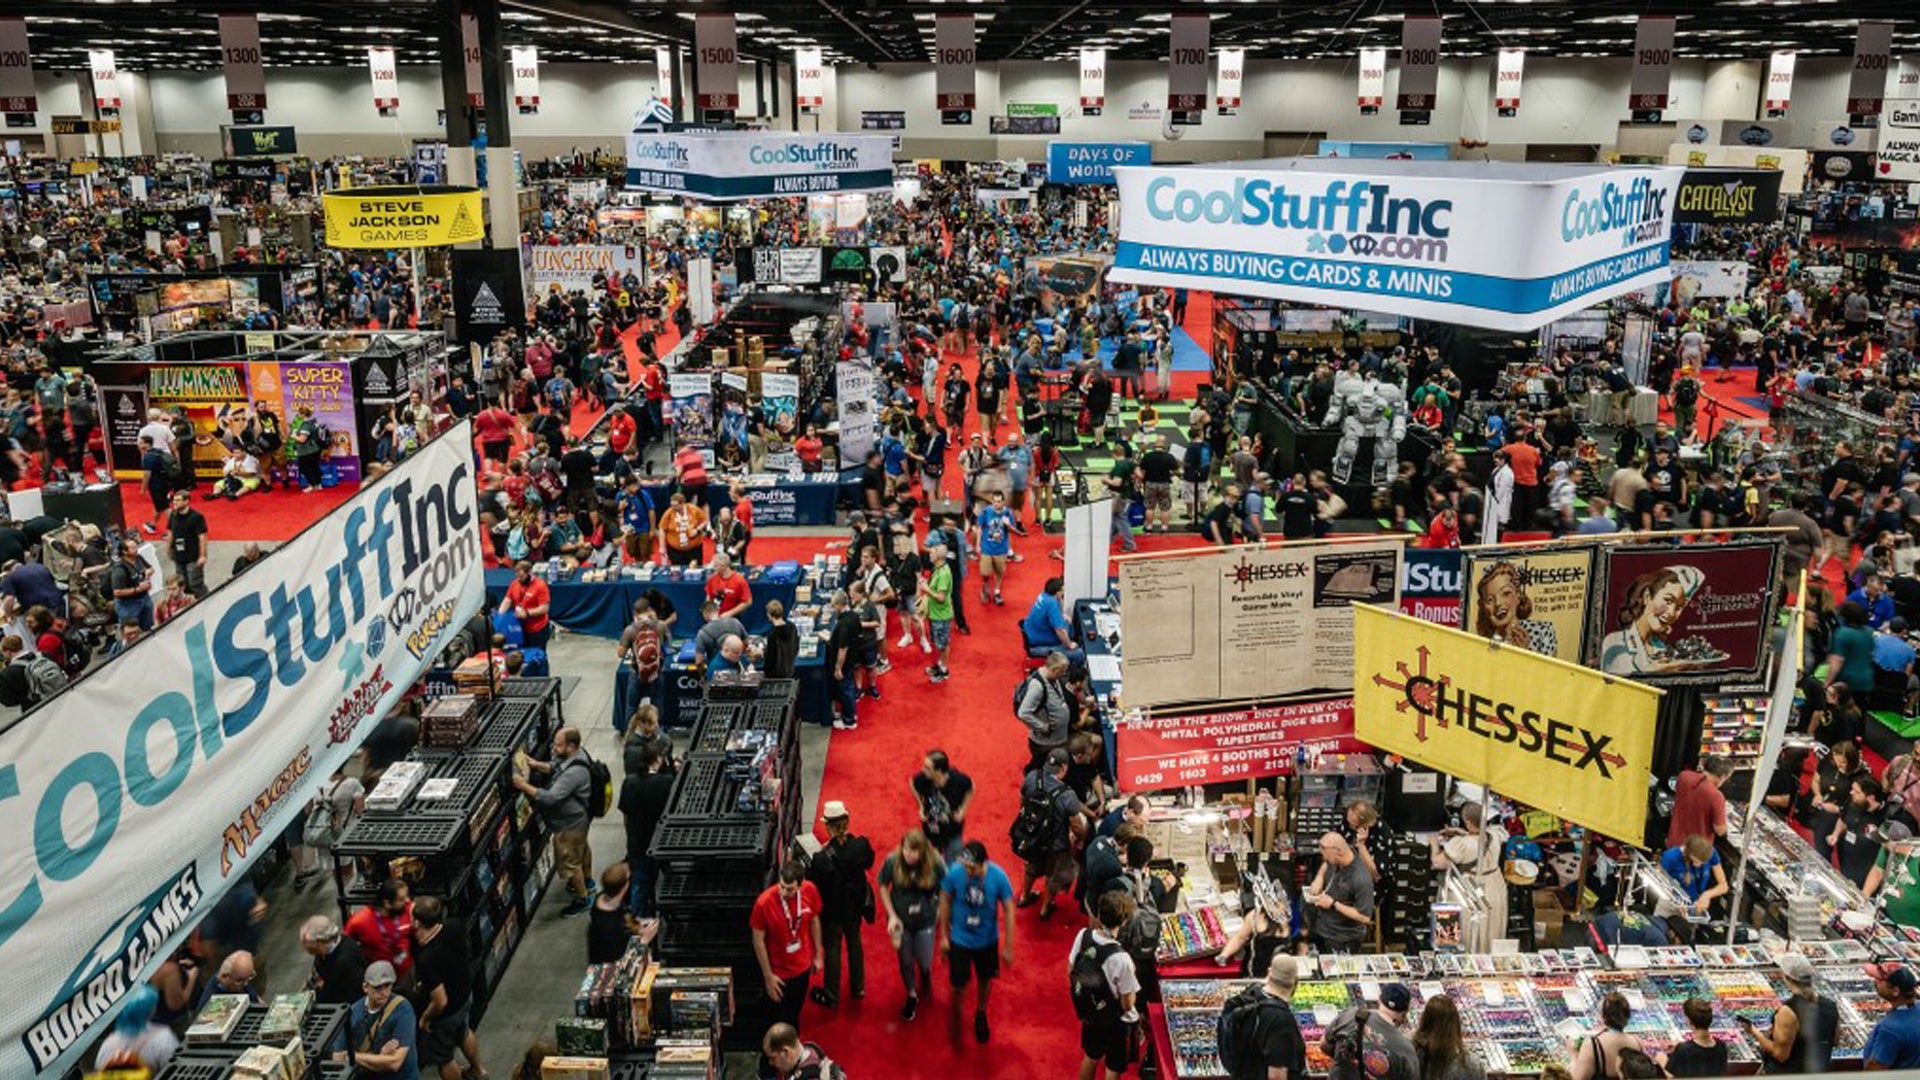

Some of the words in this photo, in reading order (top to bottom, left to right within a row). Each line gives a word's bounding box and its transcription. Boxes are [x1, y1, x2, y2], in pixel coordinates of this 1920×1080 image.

[227, 49, 258, 64] 1300
[466, 48, 480, 63] 14
[702, 48, 734, 64] 1500
[938, 49, 973, 65] 1600
[1174, 49, 1205, 65] 1700
[1406, 50, 1436, 65] 1800
[1639, 50, 1669, 65] 1900
[1856, 54, 1888, 69] 2000
[750, 142, 858, 164] CoolStuffInc
[1068, 146, 1108, 161] DAYS
[1112, 148, 1134, 161] OF
[1886, 141, 1920, 151] ALWAY
[774, 176, 807, 192] ALWAYS
[360, 201, 424, 212] STEVE
[1146, 176, 1453, 238] CoolStuffInc
[1562, 176, 1667, 242] CoolStuffInc
[1680, 184, 1757, 217] CATALYST
[349, 214, 440, 228] JACKSON
[360, 229, 428, 242] GAMES
[1373, 233, 1448, 262] .com
[534, 249, 614, 270] UNCHKIN
[1139, 247, 1209, 273] ALWAYS
[1212, 251, 1289, 279] BUYING
[1290, 261, 1361, 288] CARDS
[1367, 268, 1380, 289] &
[1387, 270, 1453, 298] MINIS
[1549, 270, 1585, 302] ALWAYS
[1585, 261, 1614, 288] BUYING
[149, 366, 241, 397] ILLUMINATI
[286, 367, 344, 383] SUPER
[292, 385, 339, 400] KITTY
[414, 527, 477, 616] .com
[1236, 562, 1307, 583] CHESSEX
[1415, 602, 1461, 623] Bonus
[1126, 720, 1154, 730] NEW
[1157, 719, 1180, 728] FOR
[1184, 715, 1207, 726] THE
[1254, 709, 1280, 719] DICE
[1284, 707, 1297, 716] IN
[1300, 704, 1326, 714] NEW
[1161, 729, 1199, 739] METAL
[1203, 720, 1278, 736] POLYHEDRAL
[1281, 718, 1307, 727] DICE
[1310, 713, 1339, 724] SETS
[1405, 675, 1613, 780] CHESSEX
[1217, 730, 1284, 746] TAPESTRIES
[1159, 759, 1176, 769] WE
[1180, 754, 1210, 767] HAVE
[1212, 753, 1219, 762] 4
[1222, 749, 1270, 762] BOOTHS
[1135, 773, 1163, 785] 0429
[1179, 768, 1206, 779] 1603
[1222, 763, 1249, 775] 2419
[1264, 758, 1290, 770] 2151
[27, 958, 126, 1072] BOARD
[127, 865, 200, 982] GAMES
